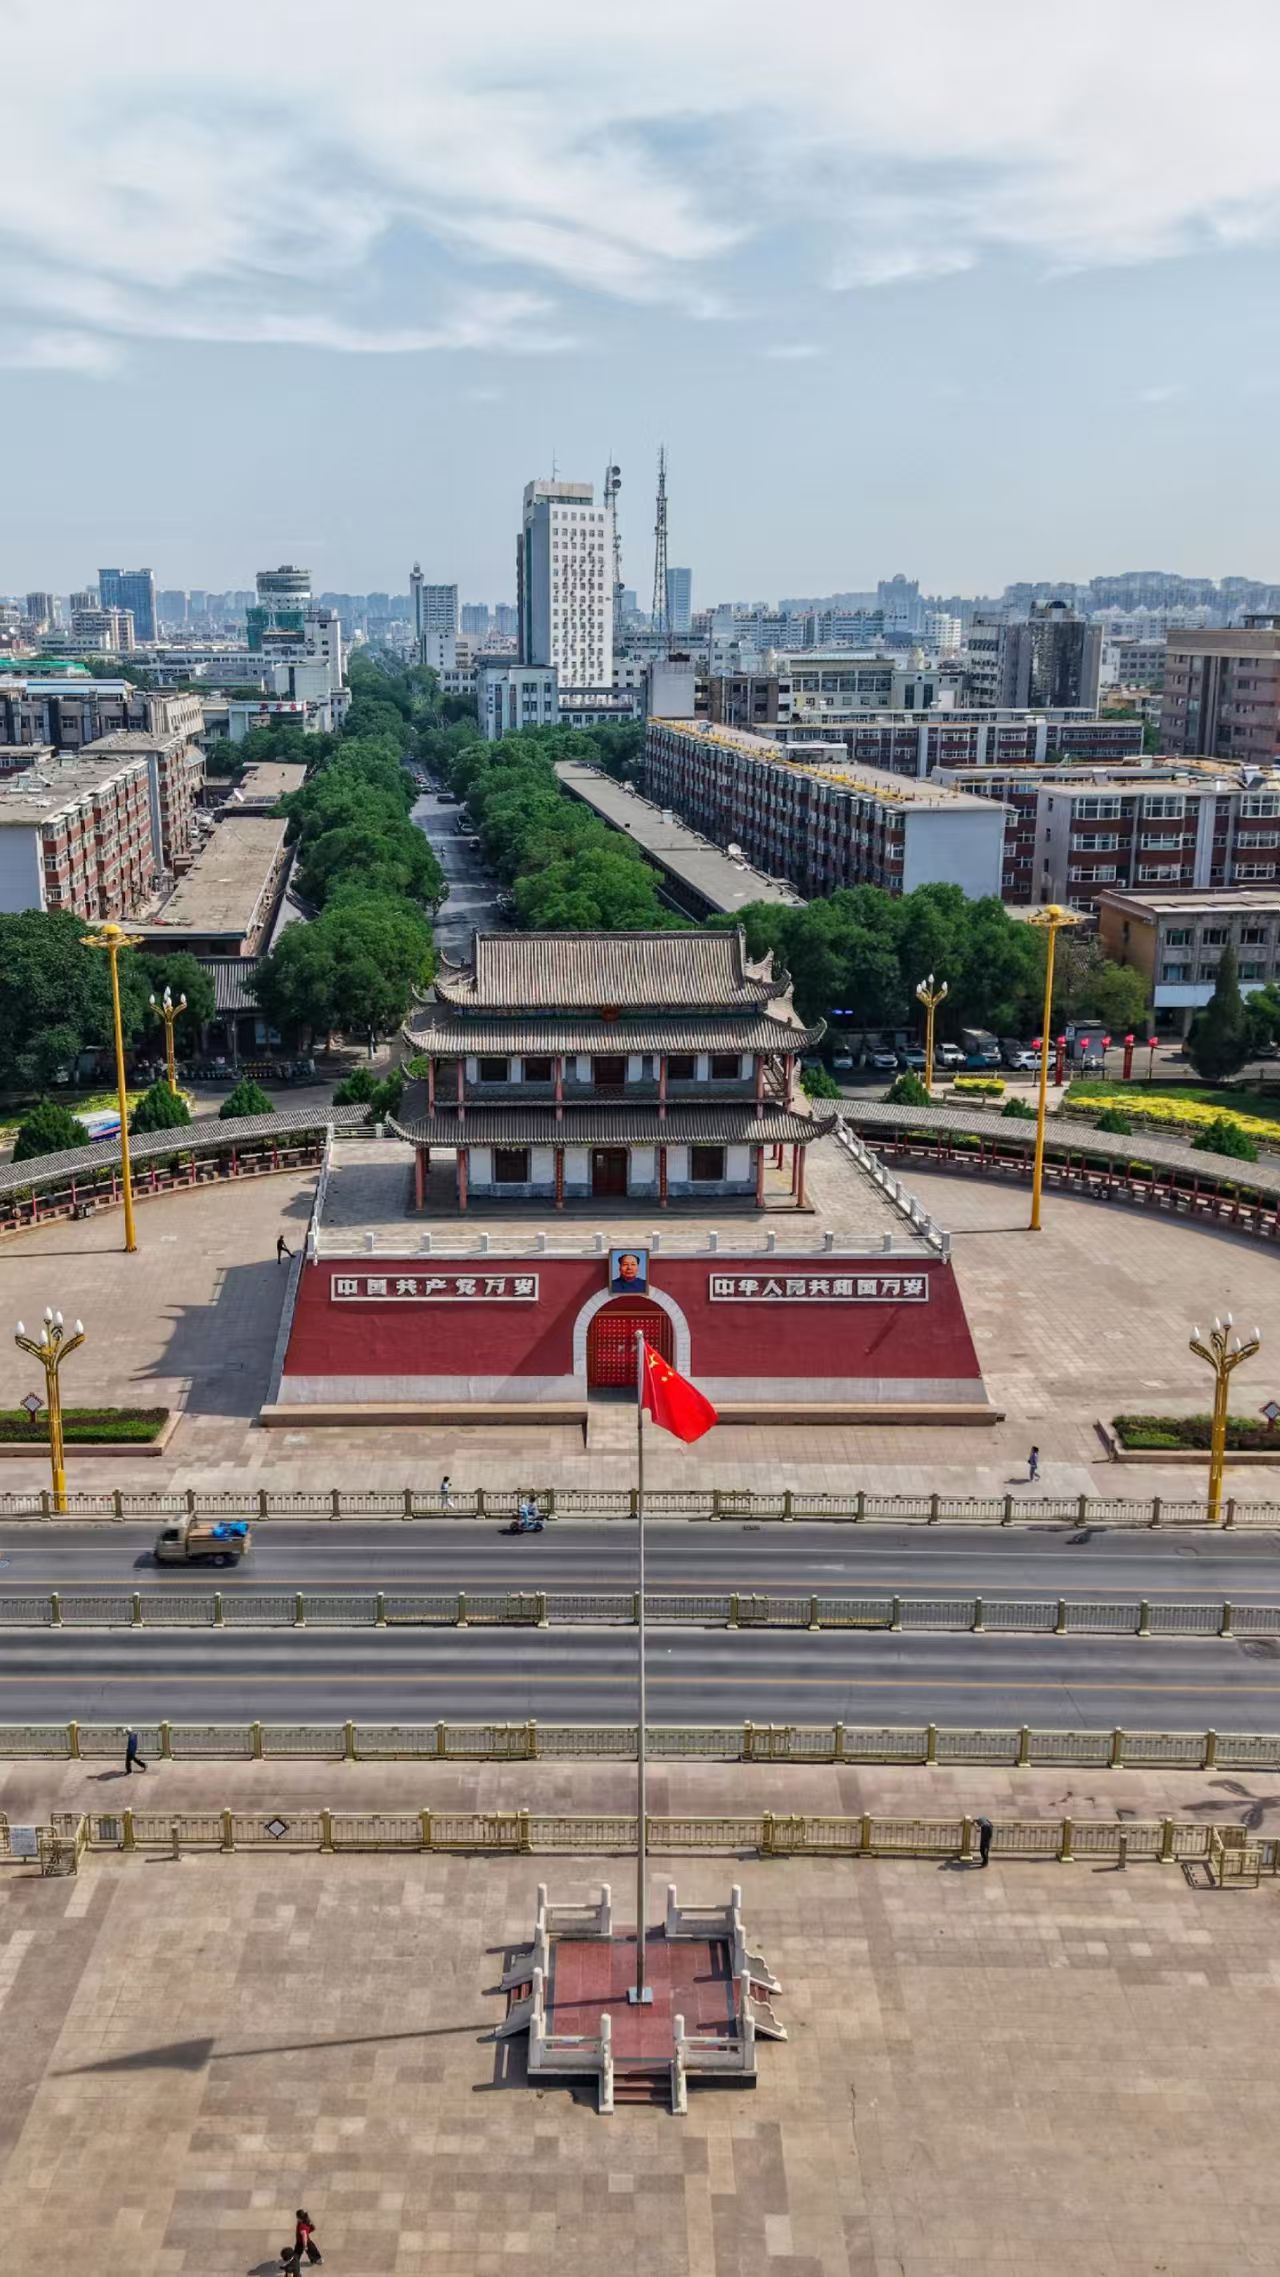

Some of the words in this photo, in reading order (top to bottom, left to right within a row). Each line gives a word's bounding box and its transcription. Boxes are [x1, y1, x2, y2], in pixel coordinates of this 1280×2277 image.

[337, 1278, 534, 1296] 中国共产党万岁
[714, 1278, 923, 1296] 中华人民共和国万岁
